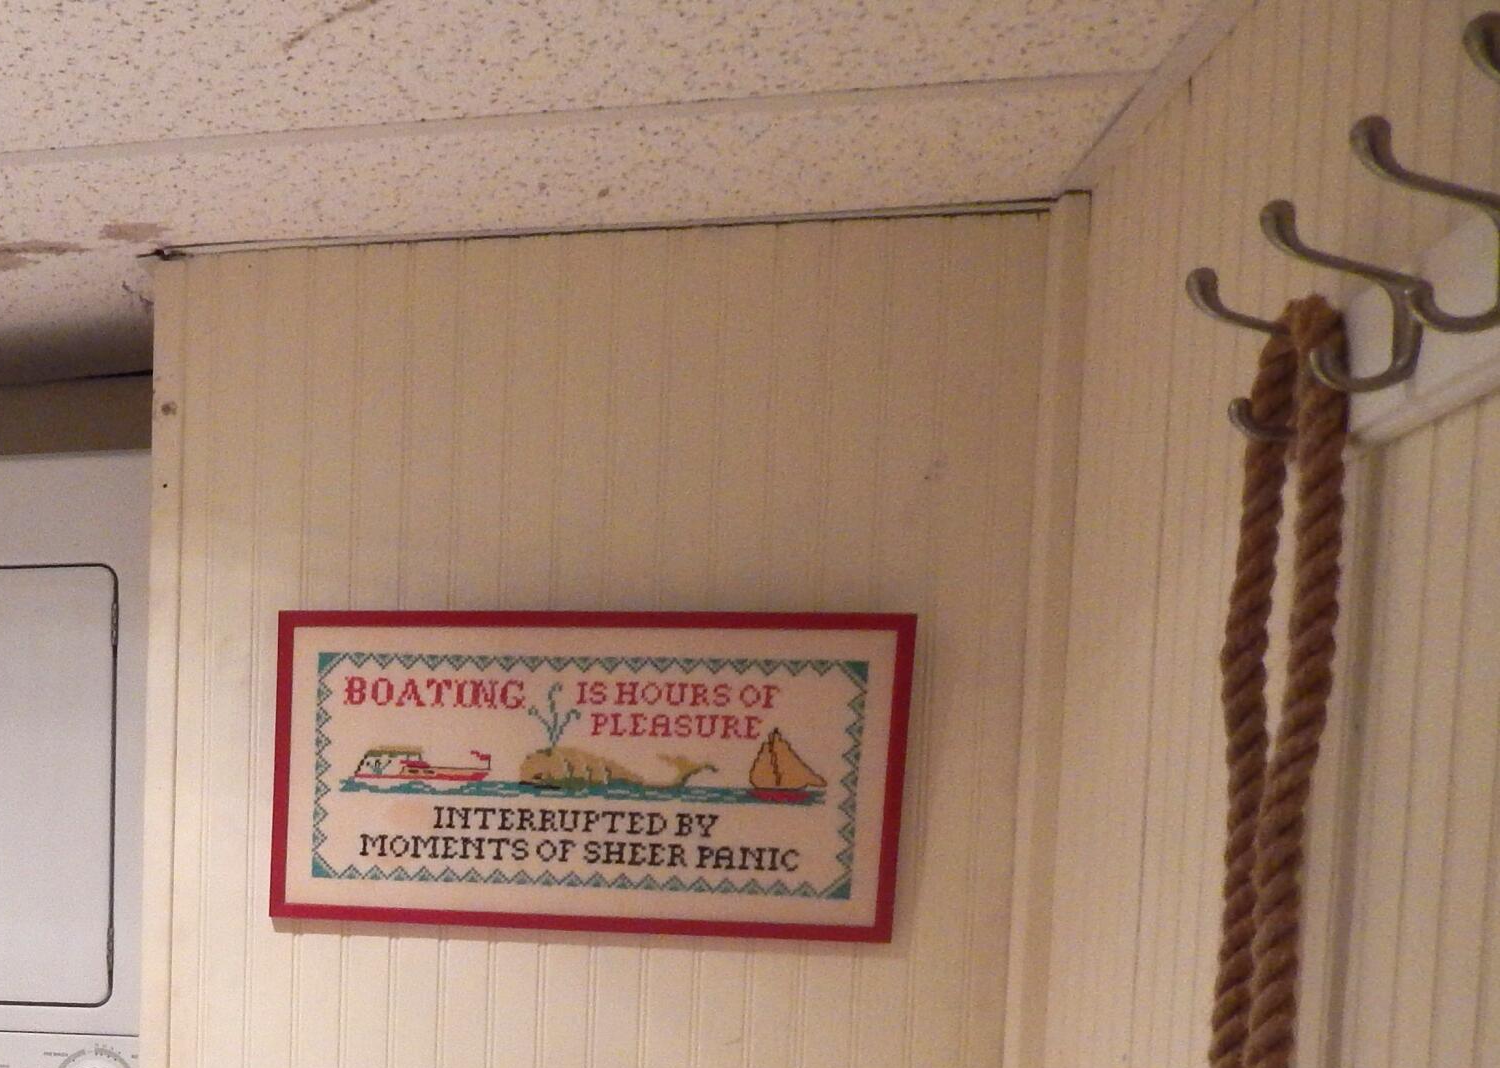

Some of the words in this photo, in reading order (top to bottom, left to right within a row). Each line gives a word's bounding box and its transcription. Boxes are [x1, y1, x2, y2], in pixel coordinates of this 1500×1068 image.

[343, 675, 526, 709] BOATING
[576, 681, 607, 705] IS
[613, 681, 732, 708] HOURS
[739, 684, 780, 709] OF
[590, 713, 763, 739] PLEASURE
[433, 806, 668, 835] INTERRUPTED
[674, 813, 719, 837] BY
[359, 833, 529, 861] MOMENTS
[536, 839, 577, 863] OF
[583, 840, 689, 868] SHEER
[695, 845, 801, 871] PANIC
